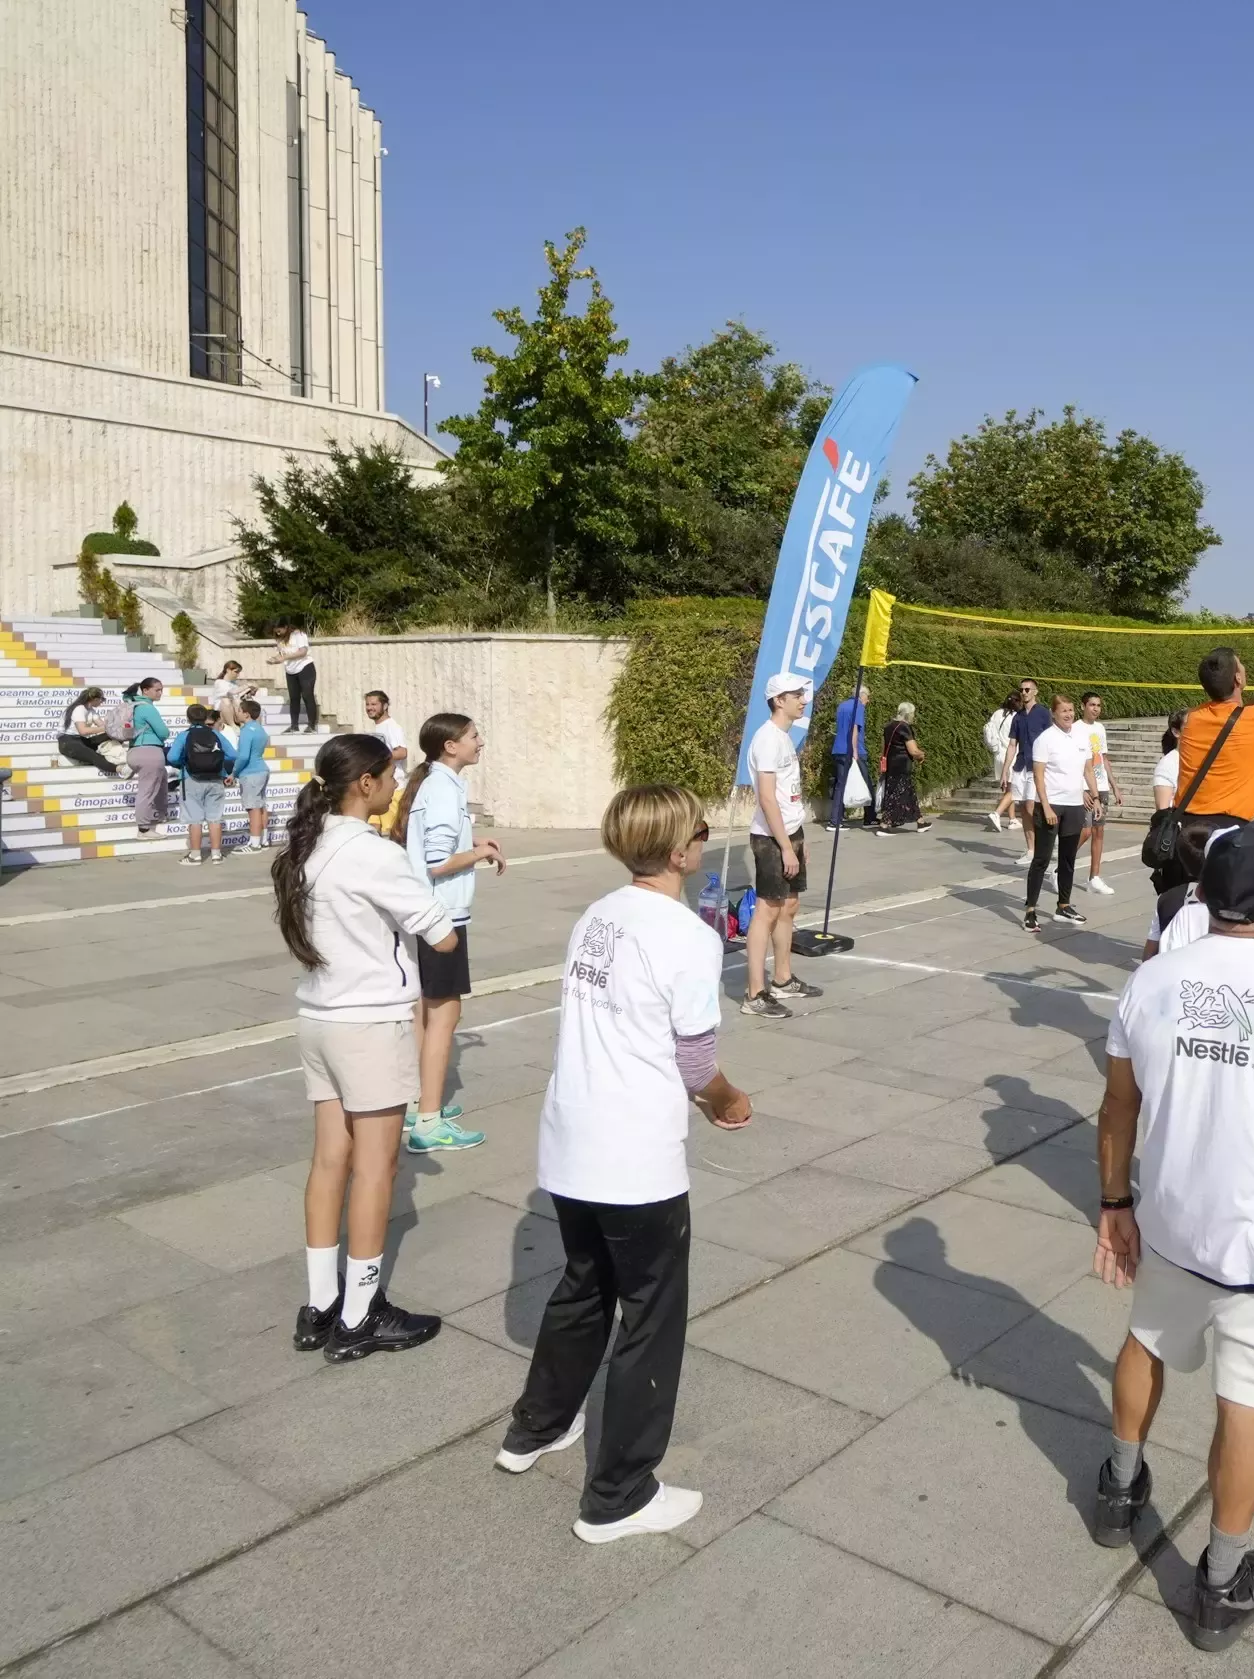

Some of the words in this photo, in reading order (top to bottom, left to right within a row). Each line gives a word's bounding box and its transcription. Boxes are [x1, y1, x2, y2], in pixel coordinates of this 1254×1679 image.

[780, 437, 870, 704] ESCAFÉ
[0, 690, 36, 698] огато
[52, 689, 80, 699] ражд
[45, 721, 60, 730] пр
[112, 781, 138, 793] забр
[74, 793, 136, 808] вторачва
[229, 820, 250, 832] раж
[569, 960, 609, 989] Nestlé
[1176, 1036, 1251, 1067] Nestlé
